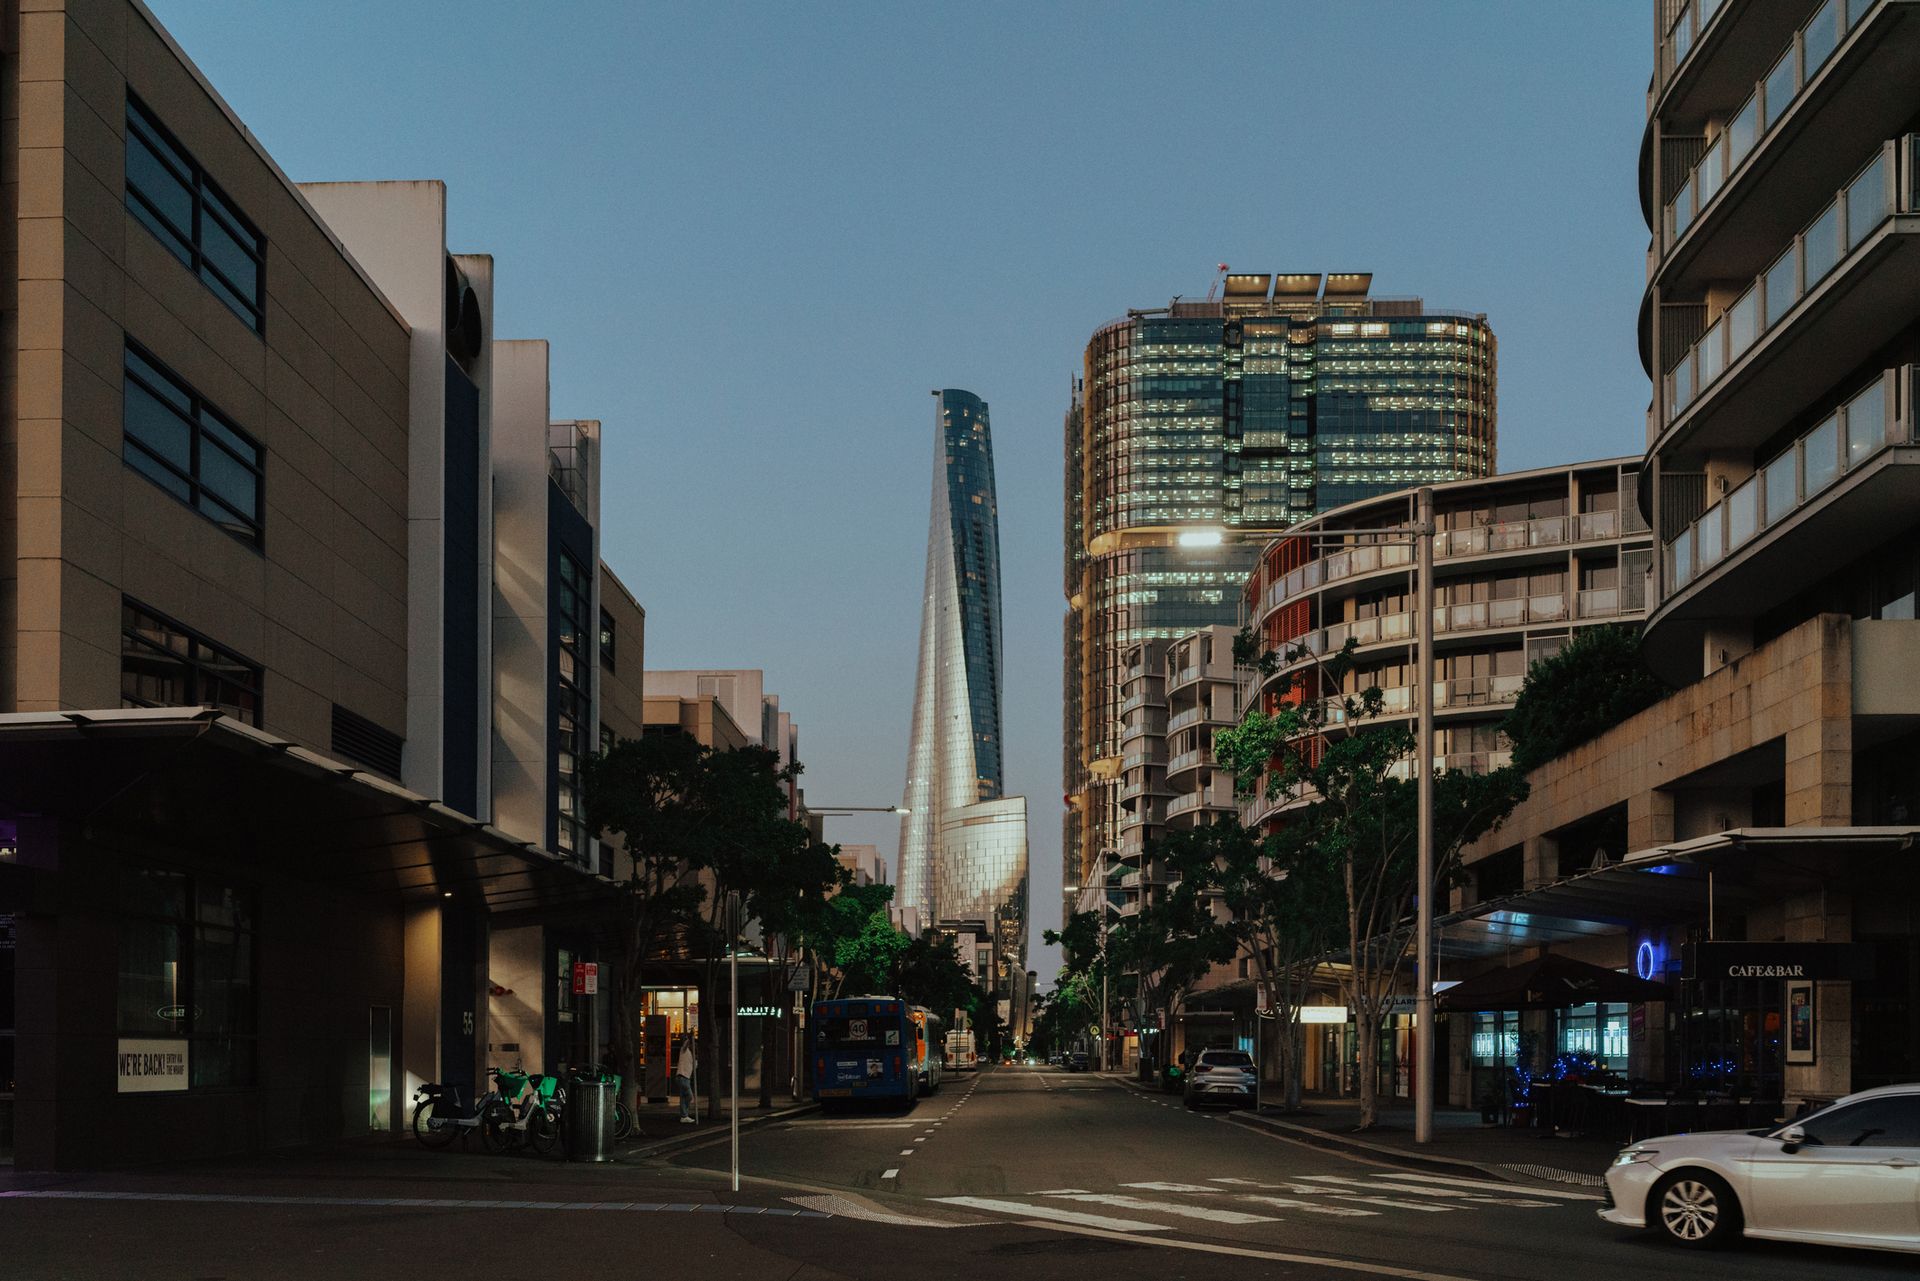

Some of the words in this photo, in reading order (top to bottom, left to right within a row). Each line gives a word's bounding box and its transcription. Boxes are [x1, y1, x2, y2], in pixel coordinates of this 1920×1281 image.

[1728, 964, 1804, 977] CAFE&BAR
[463, 1011, 473, 1035] 55
[853, 1024, 865, 1033] 40
[119, 1053, 142, 1076] WE'RE
[143, 1053, 166, 1076] BACK!
